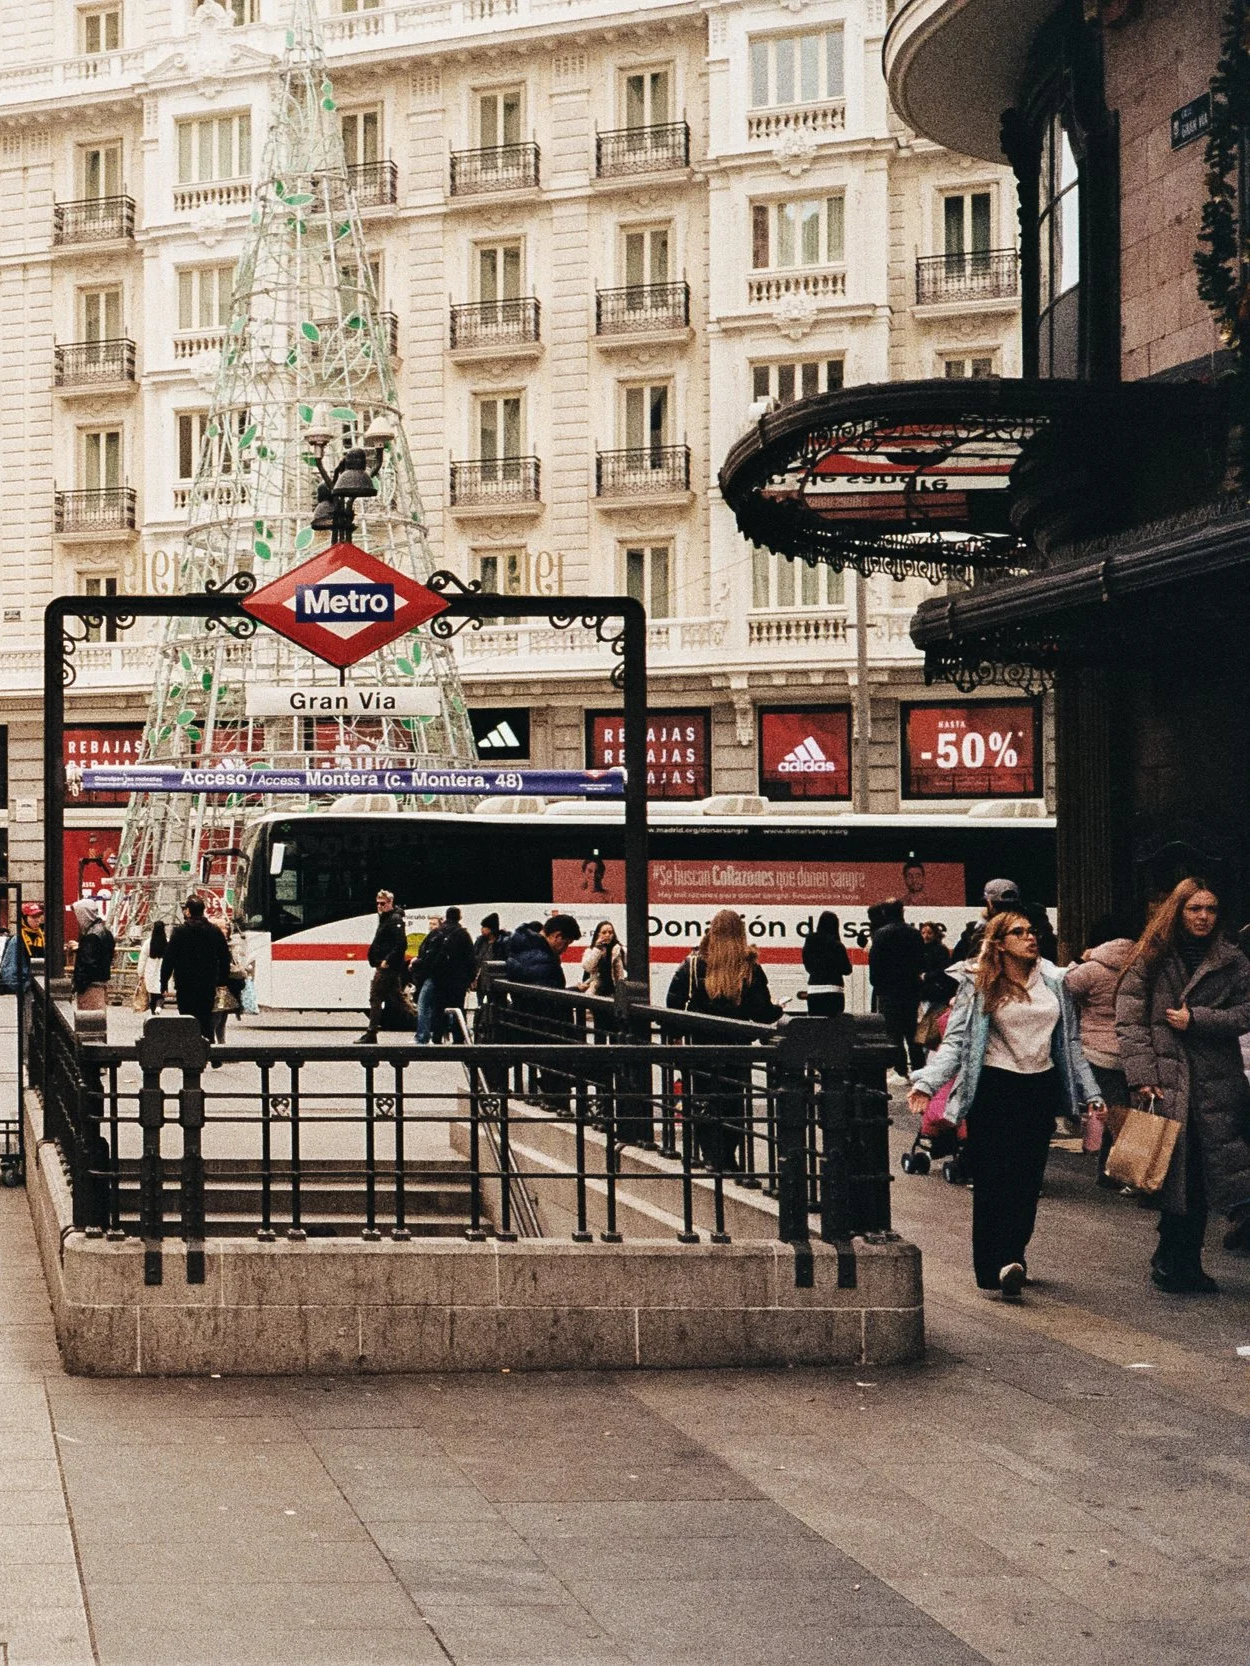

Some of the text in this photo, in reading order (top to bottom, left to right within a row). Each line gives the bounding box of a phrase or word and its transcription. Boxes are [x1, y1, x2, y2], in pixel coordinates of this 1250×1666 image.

[303, 588, 389, 615] Metro
[290, 691, 396, 710] Gran Vía
[938, 720, 967, 729] HASTA
[604, 727, 695, 742] REAJAS
[68, 740, 143, 754] REBAJAS
[604, 748, 695, 763] REAJAS
[777, 759, 836, 773] adidas
[181, 770, 247, 786] Acceso
[257, 774, 300, 787] Access
[306, 771, 378, 787] Montera
[385, 771, 406, 789] (c.
[412, 772, 490, 790] Montera,
[494, 772, 523, 790] 48)
[647, 826, 749, 835] w.madrid.org/donarsangre
[674, 865, 710, 887] buscan
[831, 870, 866, 892] sangre
